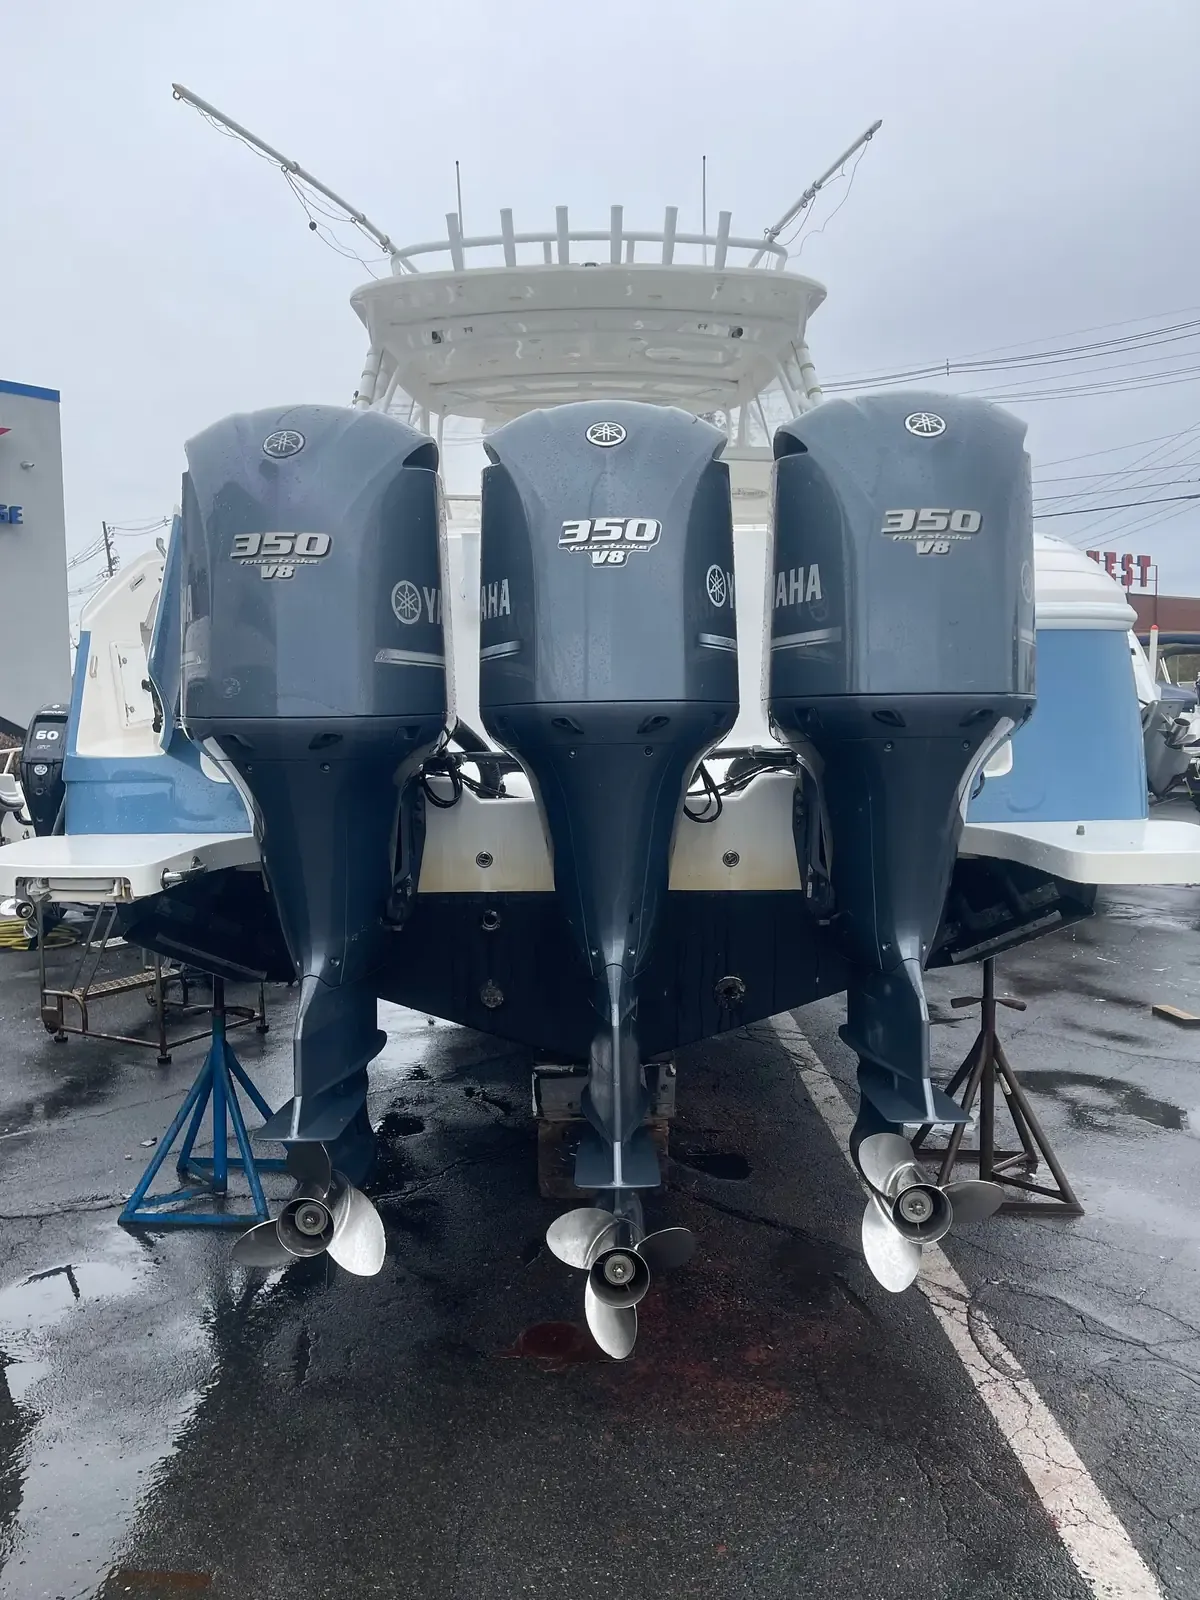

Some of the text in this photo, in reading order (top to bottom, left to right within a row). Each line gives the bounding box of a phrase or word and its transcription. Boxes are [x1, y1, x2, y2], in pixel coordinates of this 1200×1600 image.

[559, 518, 657, 544] 350
[881, 508, 981, 533] 350
[230, 532, 331, 557] 350
[916, 541, 950, 554] V8
[592, 551, 625, 564] V8
[1086, 550, 1151, 587] EST
[261, 565, 295, 579] V8
[772, 563, 822, 609] AHA
[35, 730, 59, 741] 60
